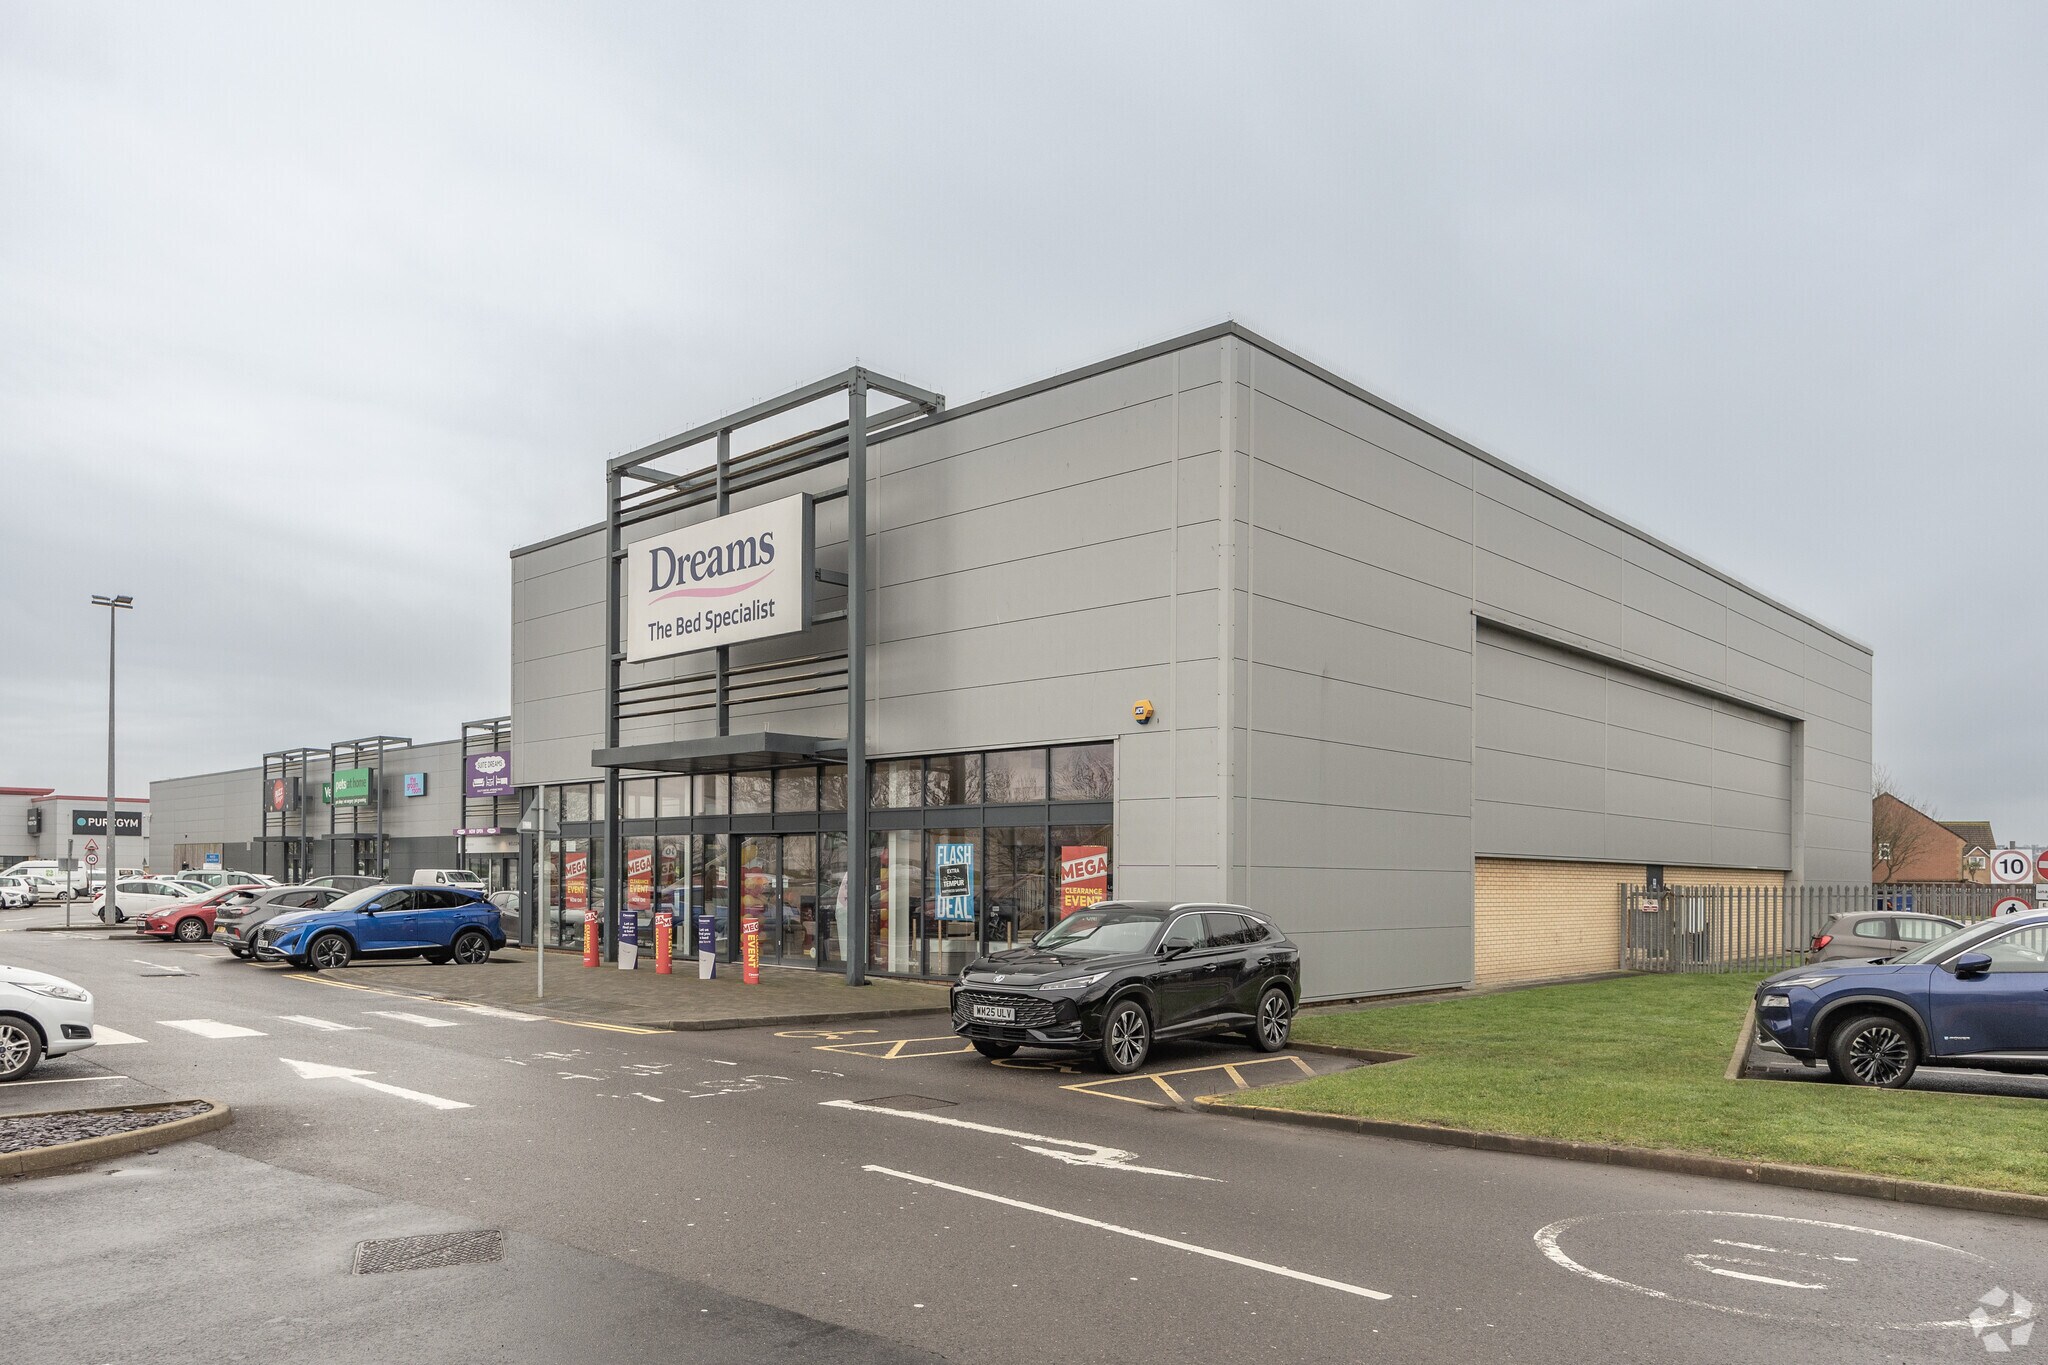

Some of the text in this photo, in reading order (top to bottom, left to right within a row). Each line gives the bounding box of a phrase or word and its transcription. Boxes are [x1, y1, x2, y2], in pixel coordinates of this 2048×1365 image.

[649, 532, 775, 592] Dreams
[648, 599, 775, 641] The Bed Specialist
[336, 778, 346, 792] pets
[88, 818, 138, 828] PURGYM
[938, 846, 971, 864] FLASH
[564, 860, 586, 876] MEGA
[628, 858, 651, 874] MEGA
[1062, 857, 1107, 880] MEGA
[2000, 859, 2024, 874] 10
[630, 884, 648, 893] EVENT
[938, 895, 972, 918] DEAL
[1065, 895, 1102, 906] EVENT
[748, 935, 756, 968] EVENT
